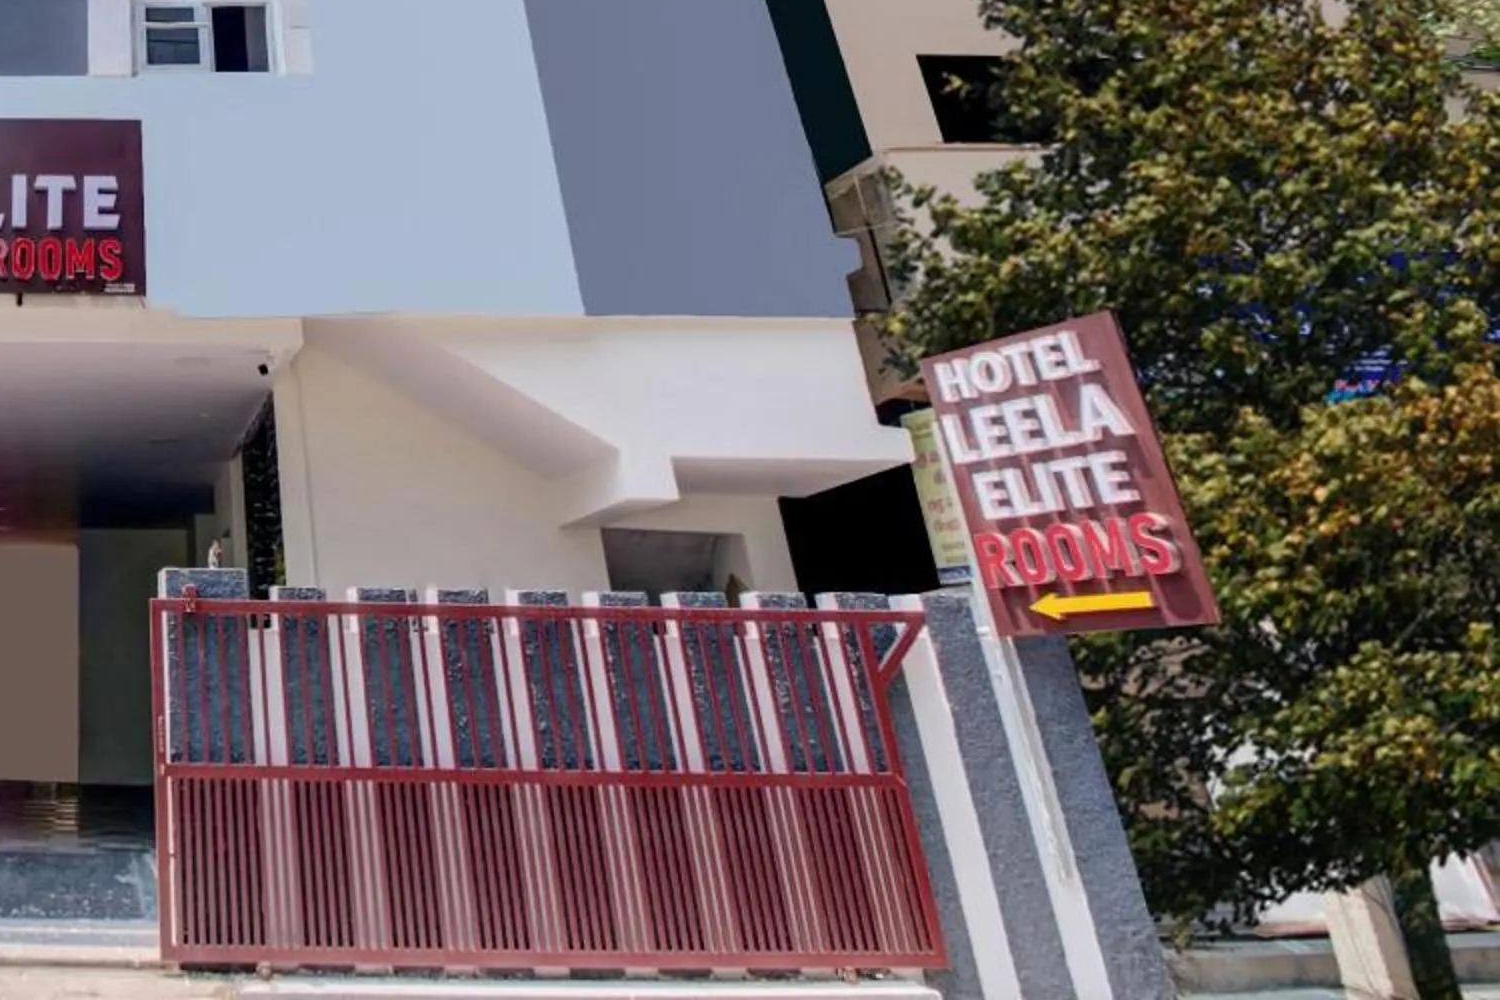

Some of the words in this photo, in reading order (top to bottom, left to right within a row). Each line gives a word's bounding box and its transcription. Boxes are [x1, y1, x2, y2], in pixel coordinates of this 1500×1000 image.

[933, 330, 1100, 403] HOTEL
[940, 383, 1136, 465] LEELA
[972, 450, 1141, 520] ELITE
[973, 512, 1182, 589] ROOMS
